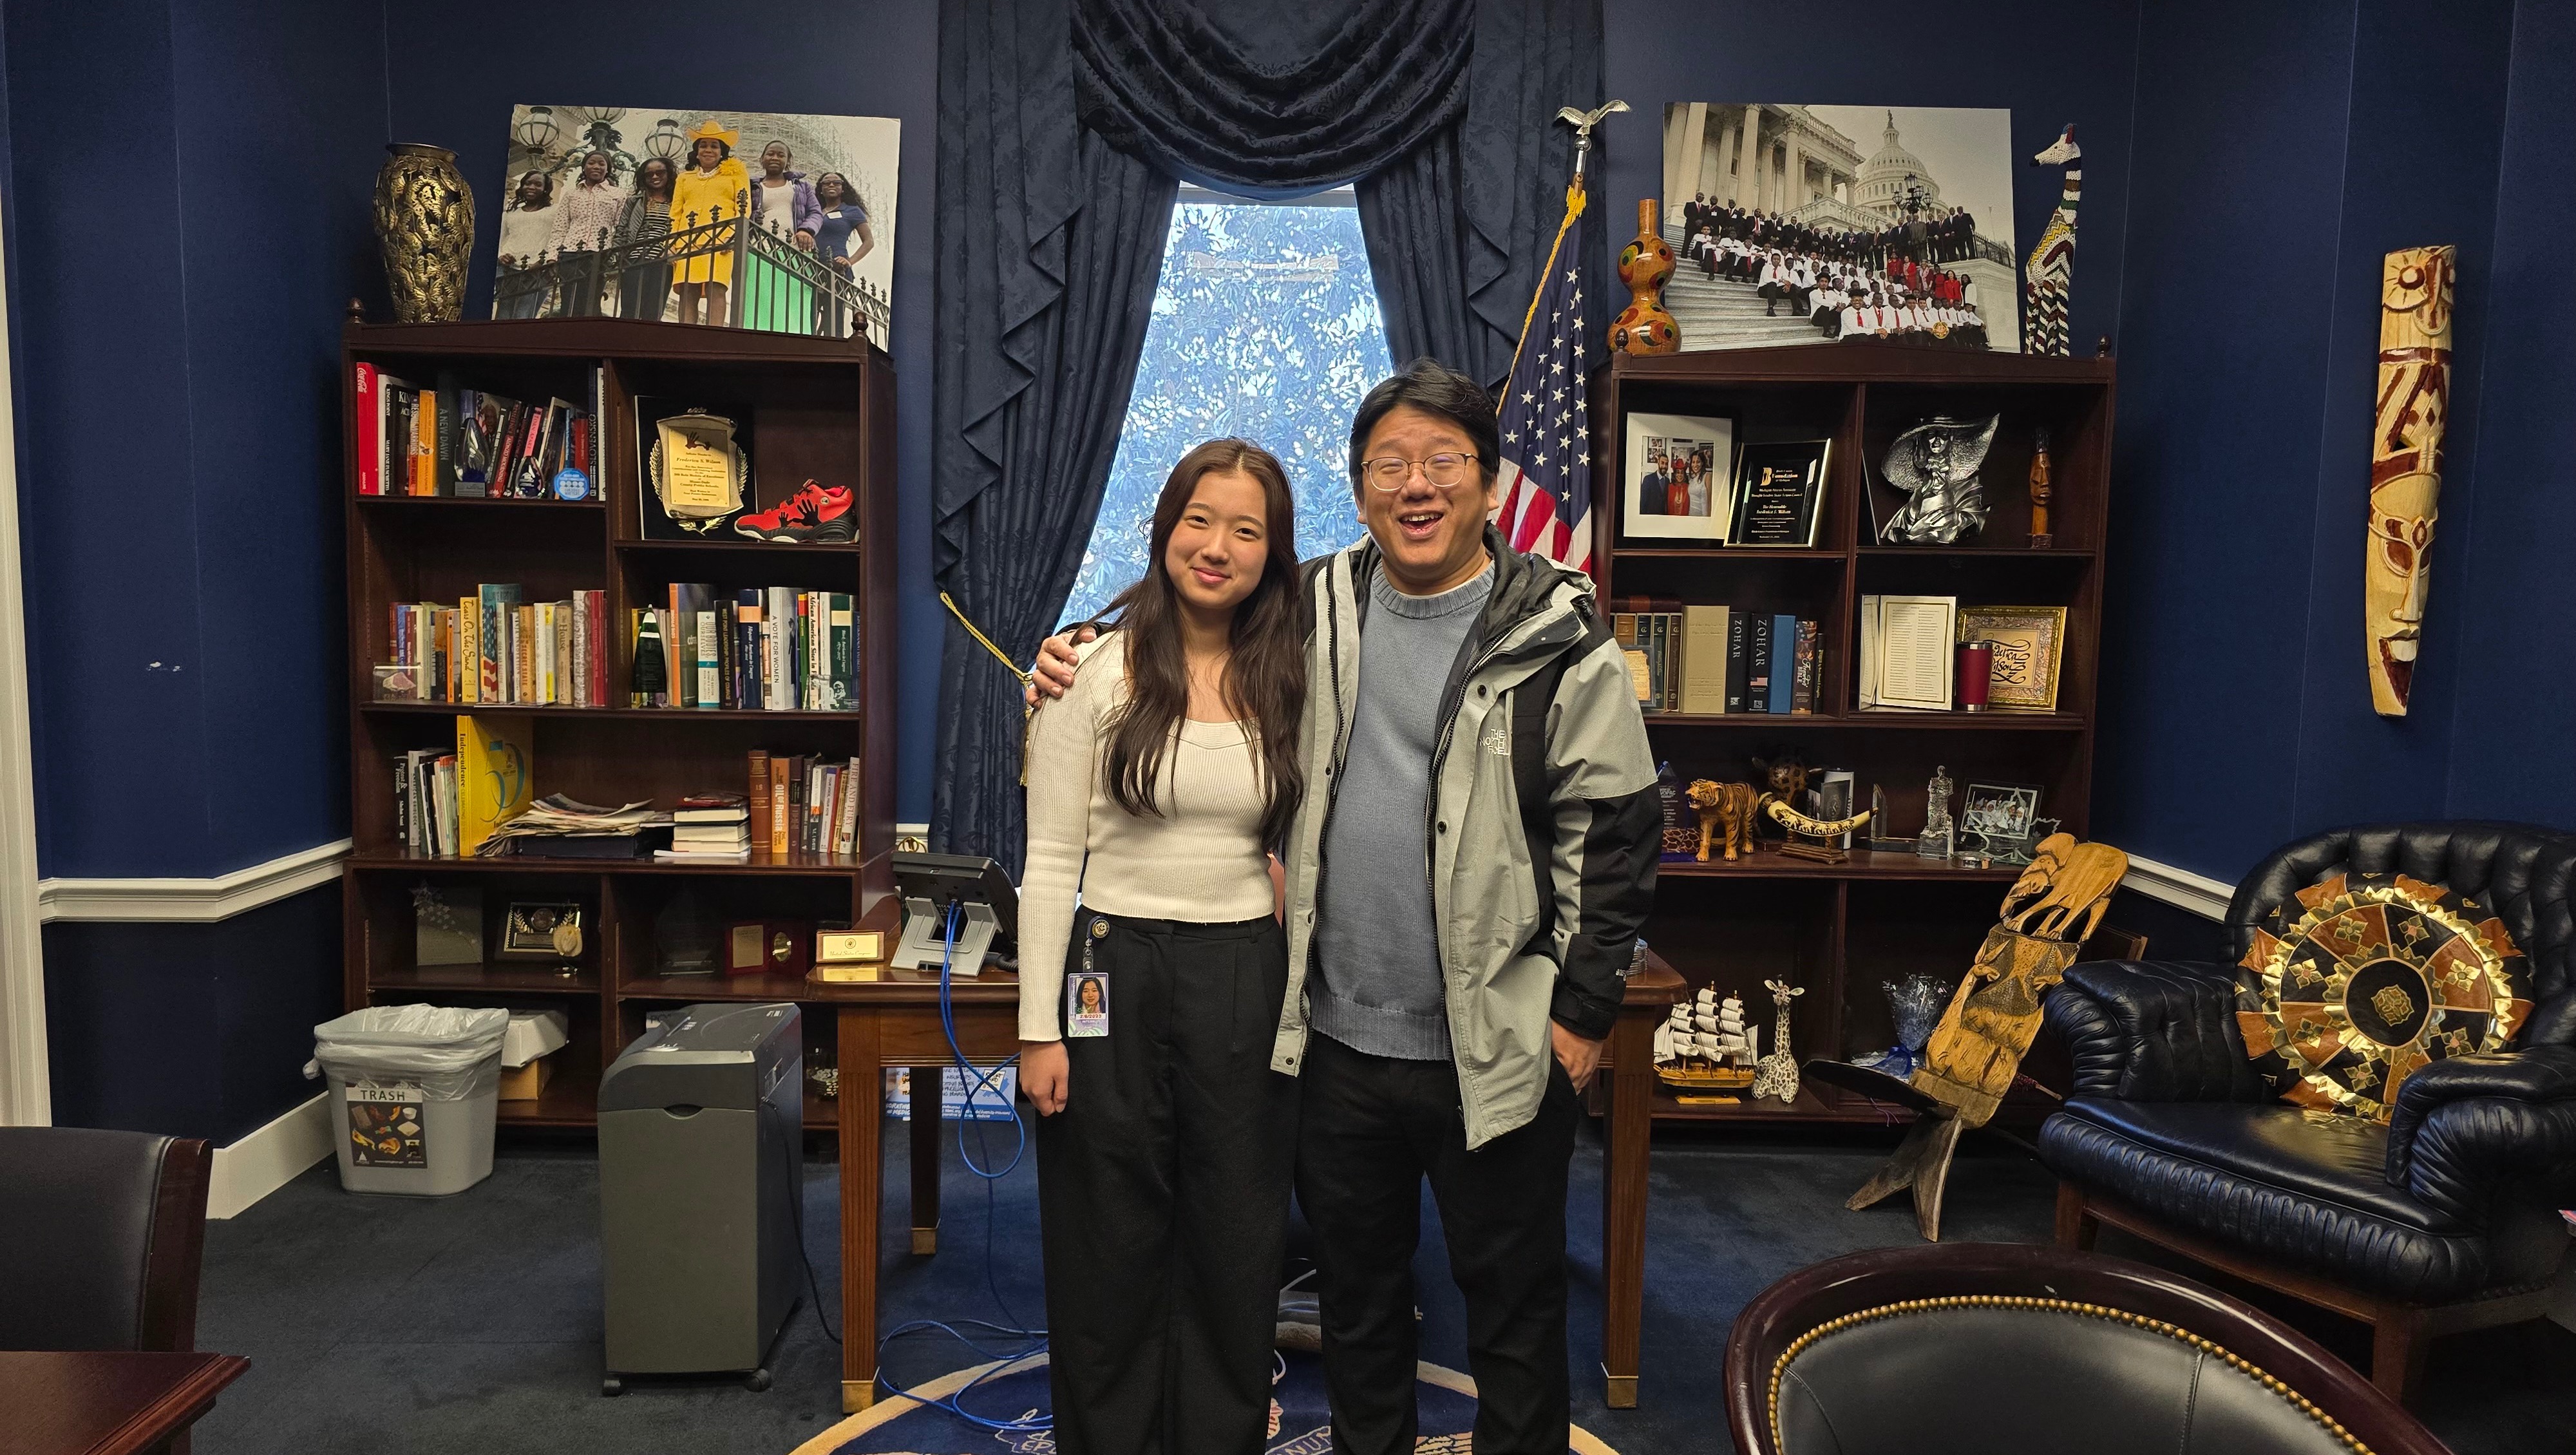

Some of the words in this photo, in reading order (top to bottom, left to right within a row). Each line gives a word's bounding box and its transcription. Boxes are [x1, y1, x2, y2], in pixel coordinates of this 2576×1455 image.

[411, 404, 419, 426] RESCUE
[529, 415, 538, 431] TORN
[440, 416, 448, 434] NEW
[410, 426, 419, 455] WARRIORS
[440, 435, 449, 461] DAWN
[503, 437, 512, 456] ALONZO
[497, 455, 509, 482] MOURNING
[463, 600, 475, 620] Tears
[463, 622, 475, 632] On
[706, 622, 715, 634] OUR
[462, 634, 475, 649] The
[558, 624, 568, 652] House
[1732, 620, 1742, 658] ZOHAR
[1756, 620, 1767, 667] ZOHAR
[462, 649, 476, 671] Sand
[1479, 737, 1505, 748] NORTH
[1491, 728, 1506, 739] THE
[851, 763, 859, 782] FIRE
[775, 785, 784, 797] OIL
[848, 784, 857, 803] AND
[775, 804, 784, 832] Russia
[846, 805, 855, 827] FURY
[361, 1090, 406, 1101] TRASH
